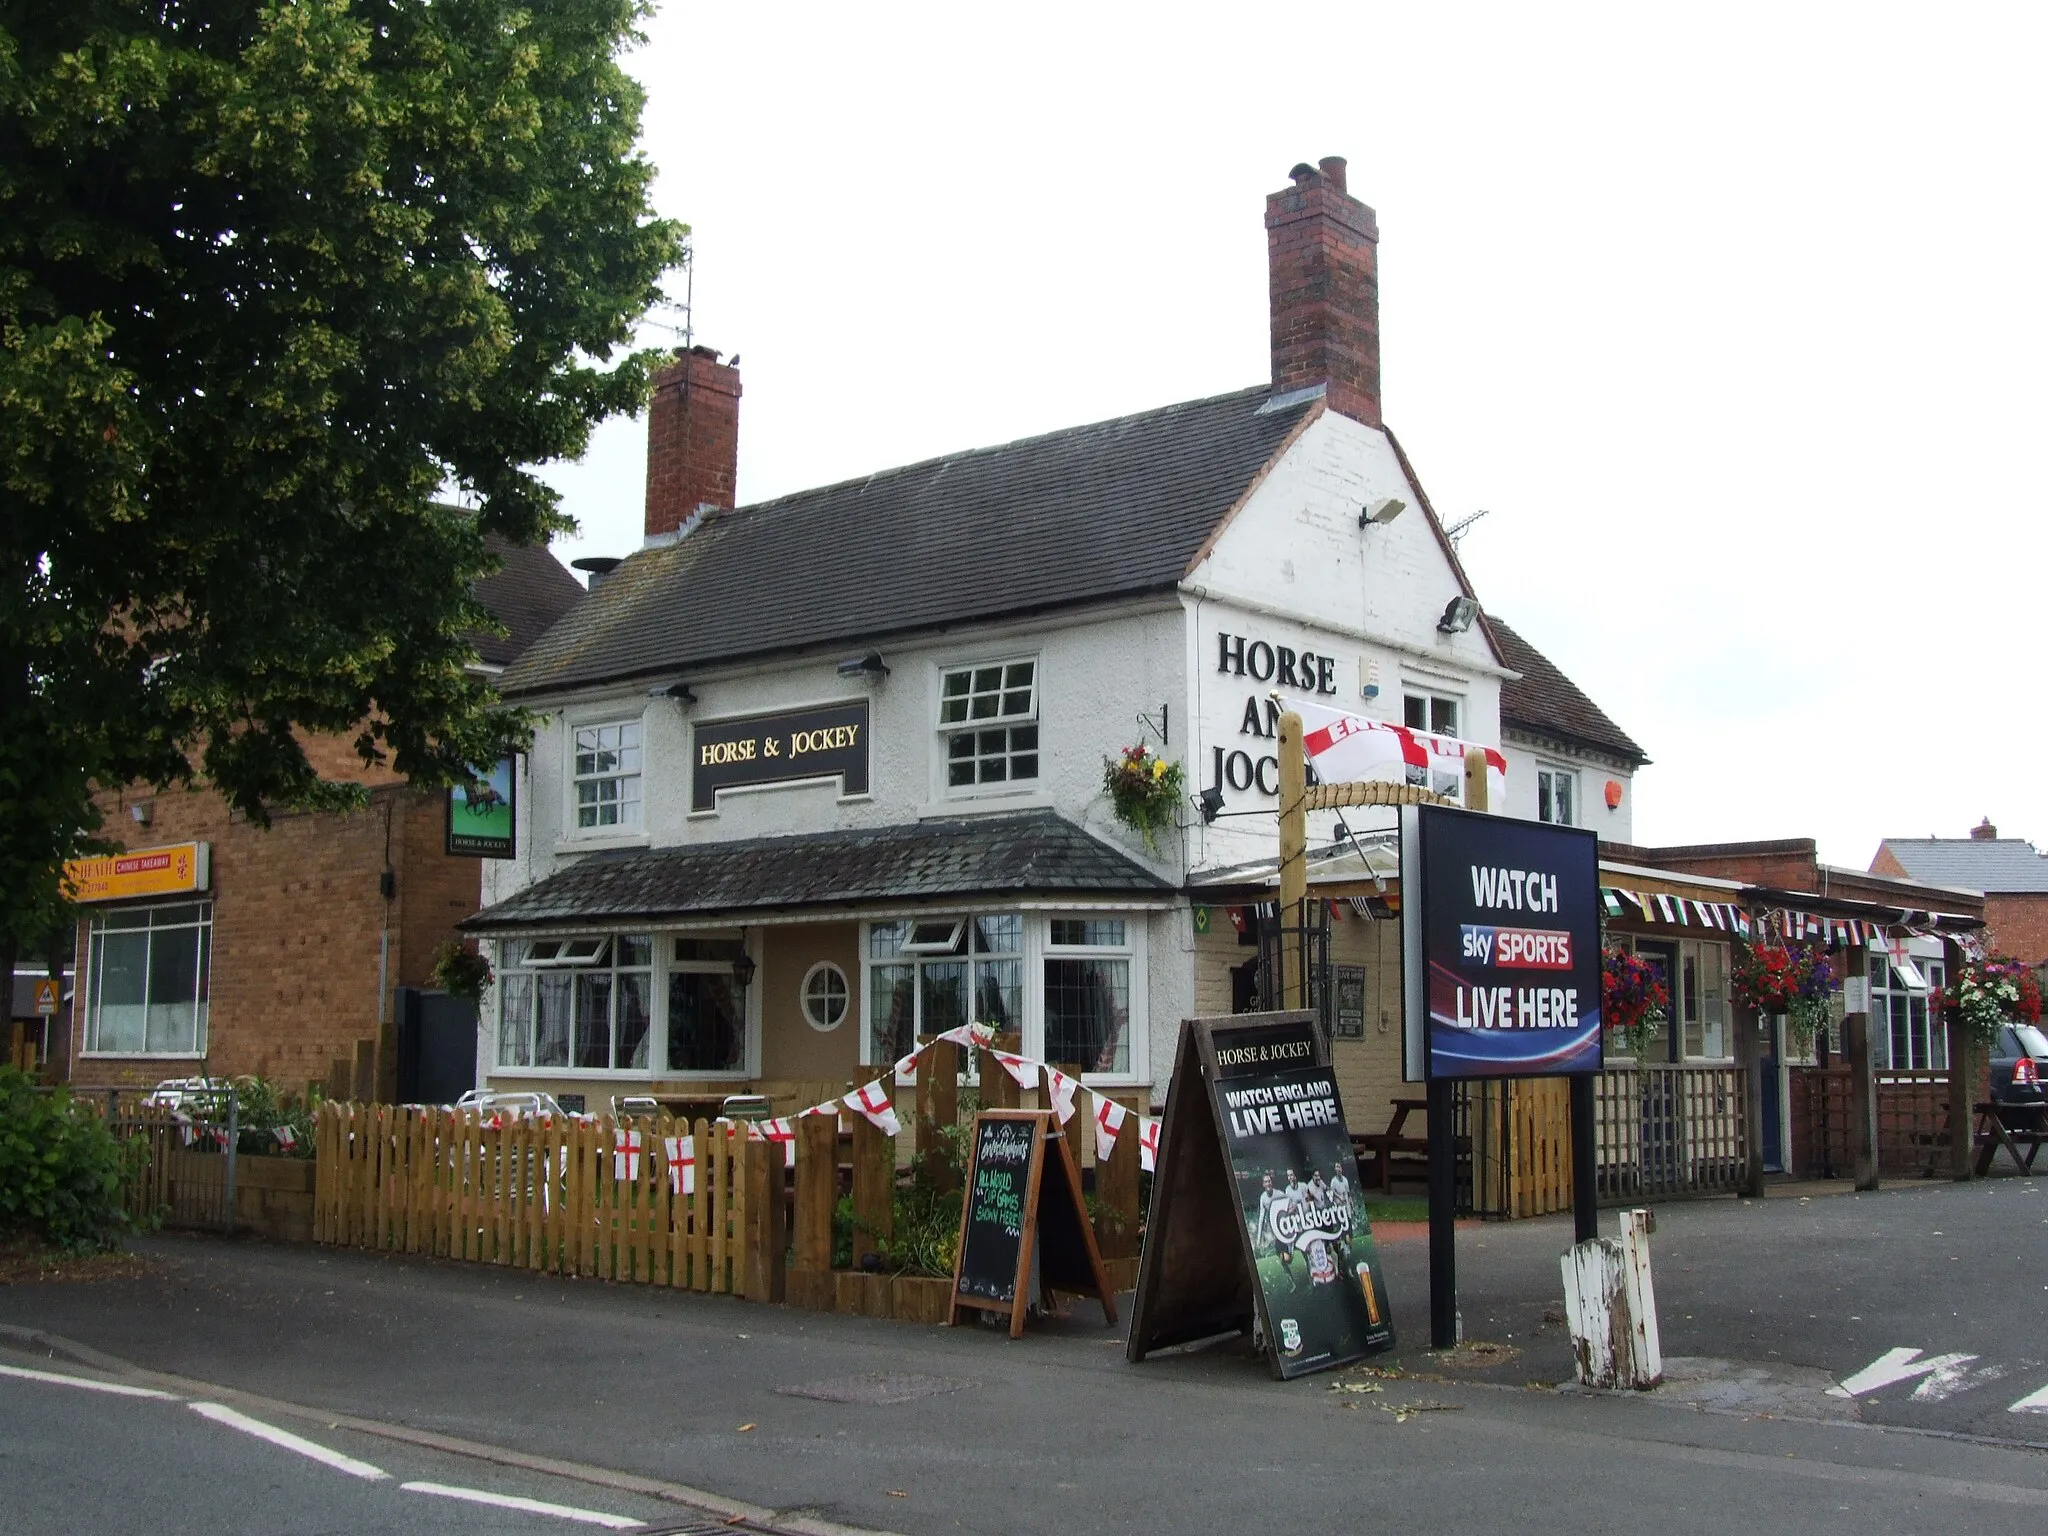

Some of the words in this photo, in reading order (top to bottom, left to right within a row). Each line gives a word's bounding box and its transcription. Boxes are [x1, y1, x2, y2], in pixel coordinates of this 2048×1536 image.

[1218, 632, 1337, 695] HORSE
[1239, 695, 1278, 739] AN
[701, 739, 756, 765] HORSE
[763, 736, 780, 757] &
[789, 724, 858, 759] JOCKEY
[455, 838, 475, 846] HORSE
[483, 840, 506, 848] JOCKEY
[116, 859, 139, 873] CHINESE
[141, 855, 170, 870] TAKEAWAY
[1471, 865, 1558, 913] WATCH
[1463, 927, 1492, 964] sky
[1498, 933, 1569, 964] SPORTS
[1457, 986, 1513, 1028] LIVE
[1518, 987, 1579, 1028] HERE
[1217, 1047, 1258, 1066] HORSE
[1260, 1045, 1269, 1061] &
[1271, 1041, 1311, 1060] JOCKEY
[1225, 1087, 1274, 1109] WATCH
[1273, 1080, 1332, 1102] ENGLAND
[1230, 1105, 1284, 1138] LIVE
[1284, 1098, 1339, 1129] HERE
[983, 1188, 997, 1204] CUP
[996, 1188, 1019, 1211] GAMES
[990, 1169, 1012, 1192] WORLD
[1269, 1198, 1351, 1249] Carlsberg
